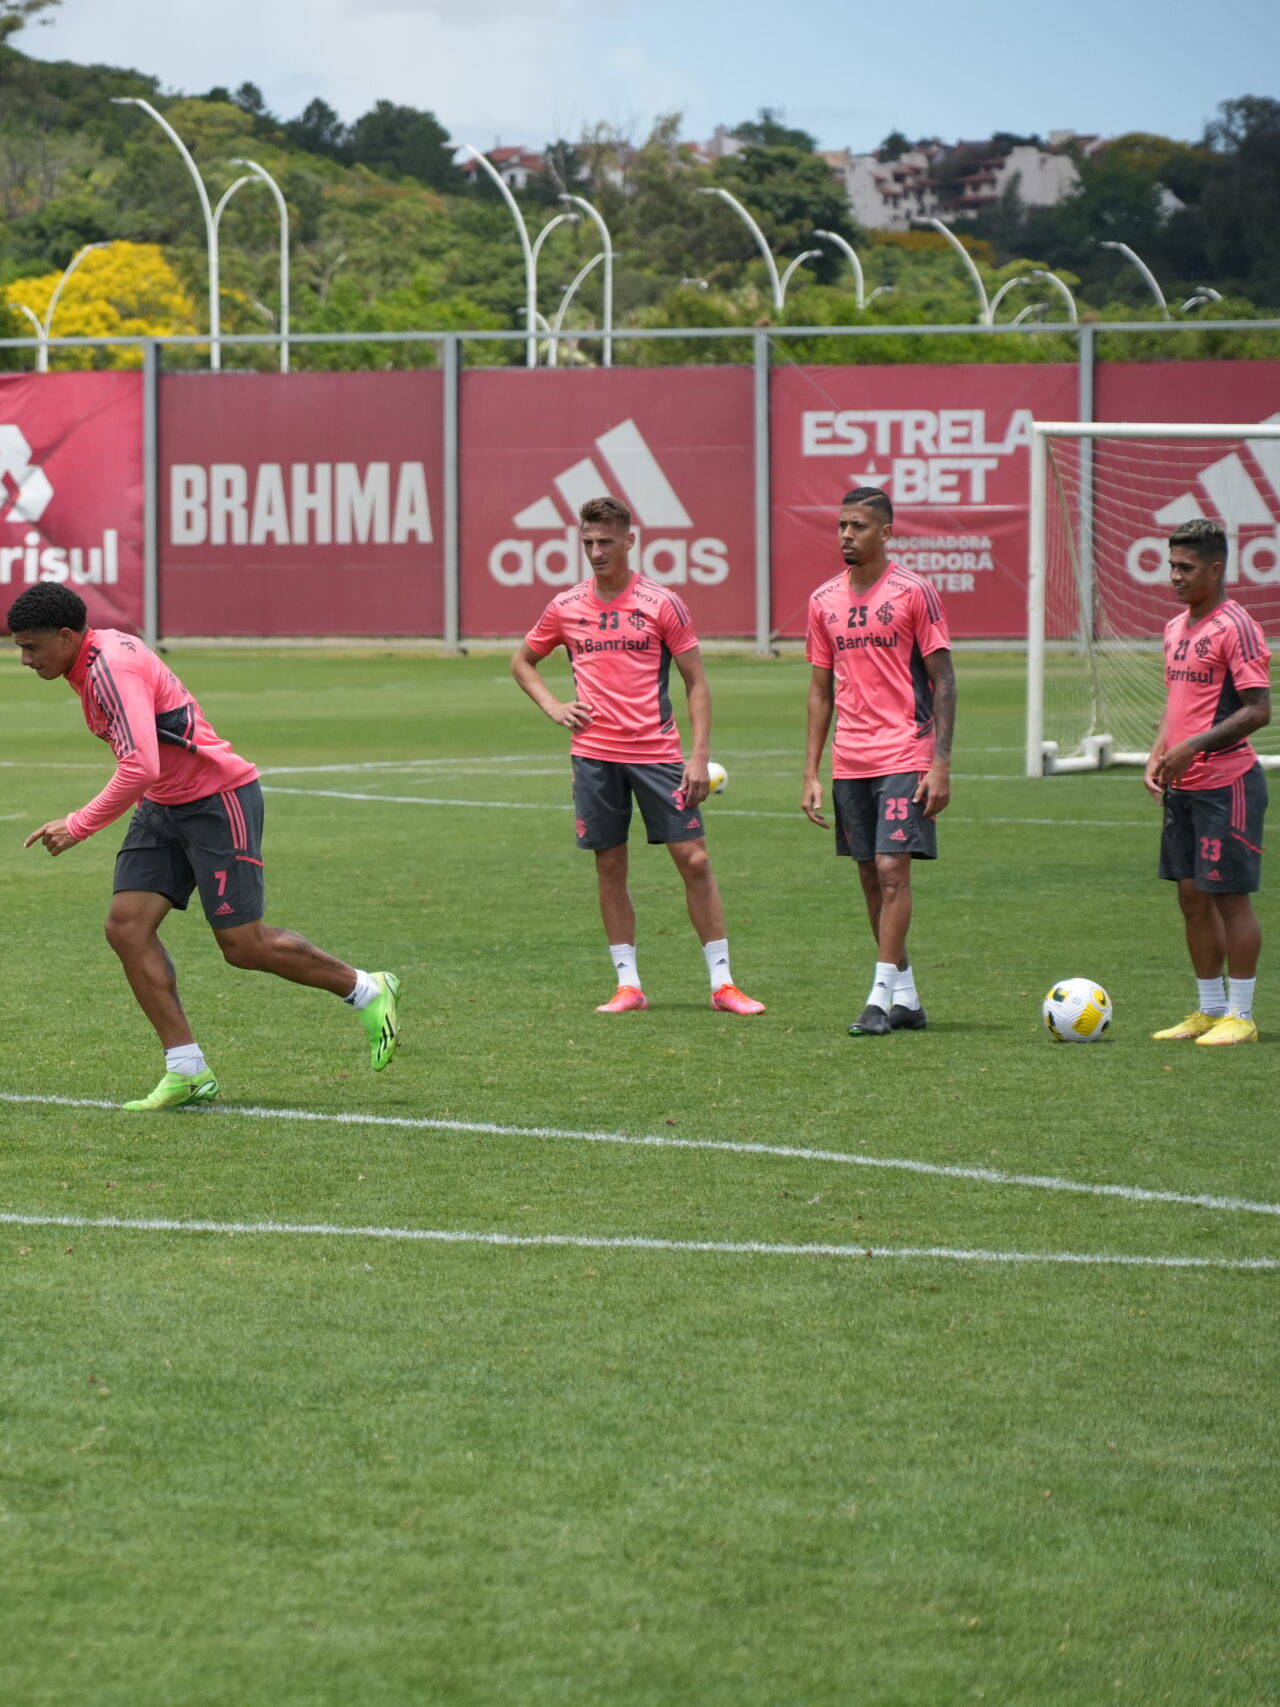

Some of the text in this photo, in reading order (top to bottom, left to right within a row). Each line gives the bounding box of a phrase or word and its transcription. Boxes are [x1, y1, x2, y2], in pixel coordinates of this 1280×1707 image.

[802, 409, 1033, 456] ESTRELA
[893, 458, 999, 504] BET
[169, 461, 433, 546] BRAHMA
[488, 525, 729, 586] adas
[632, 588, 653, 602] vero
[887, 578, 906, 592] vero
[598, 611, 620, 631] 33
[848, 606, 868, 628] 25
[584, 635, 650, 653] Banrisul
[836, 632, 898, 651] Banrisul
[885, 798, 908, 820] 25
[1200, 836, 1222, 861] 23
[214, 870, 227, 896] 7
